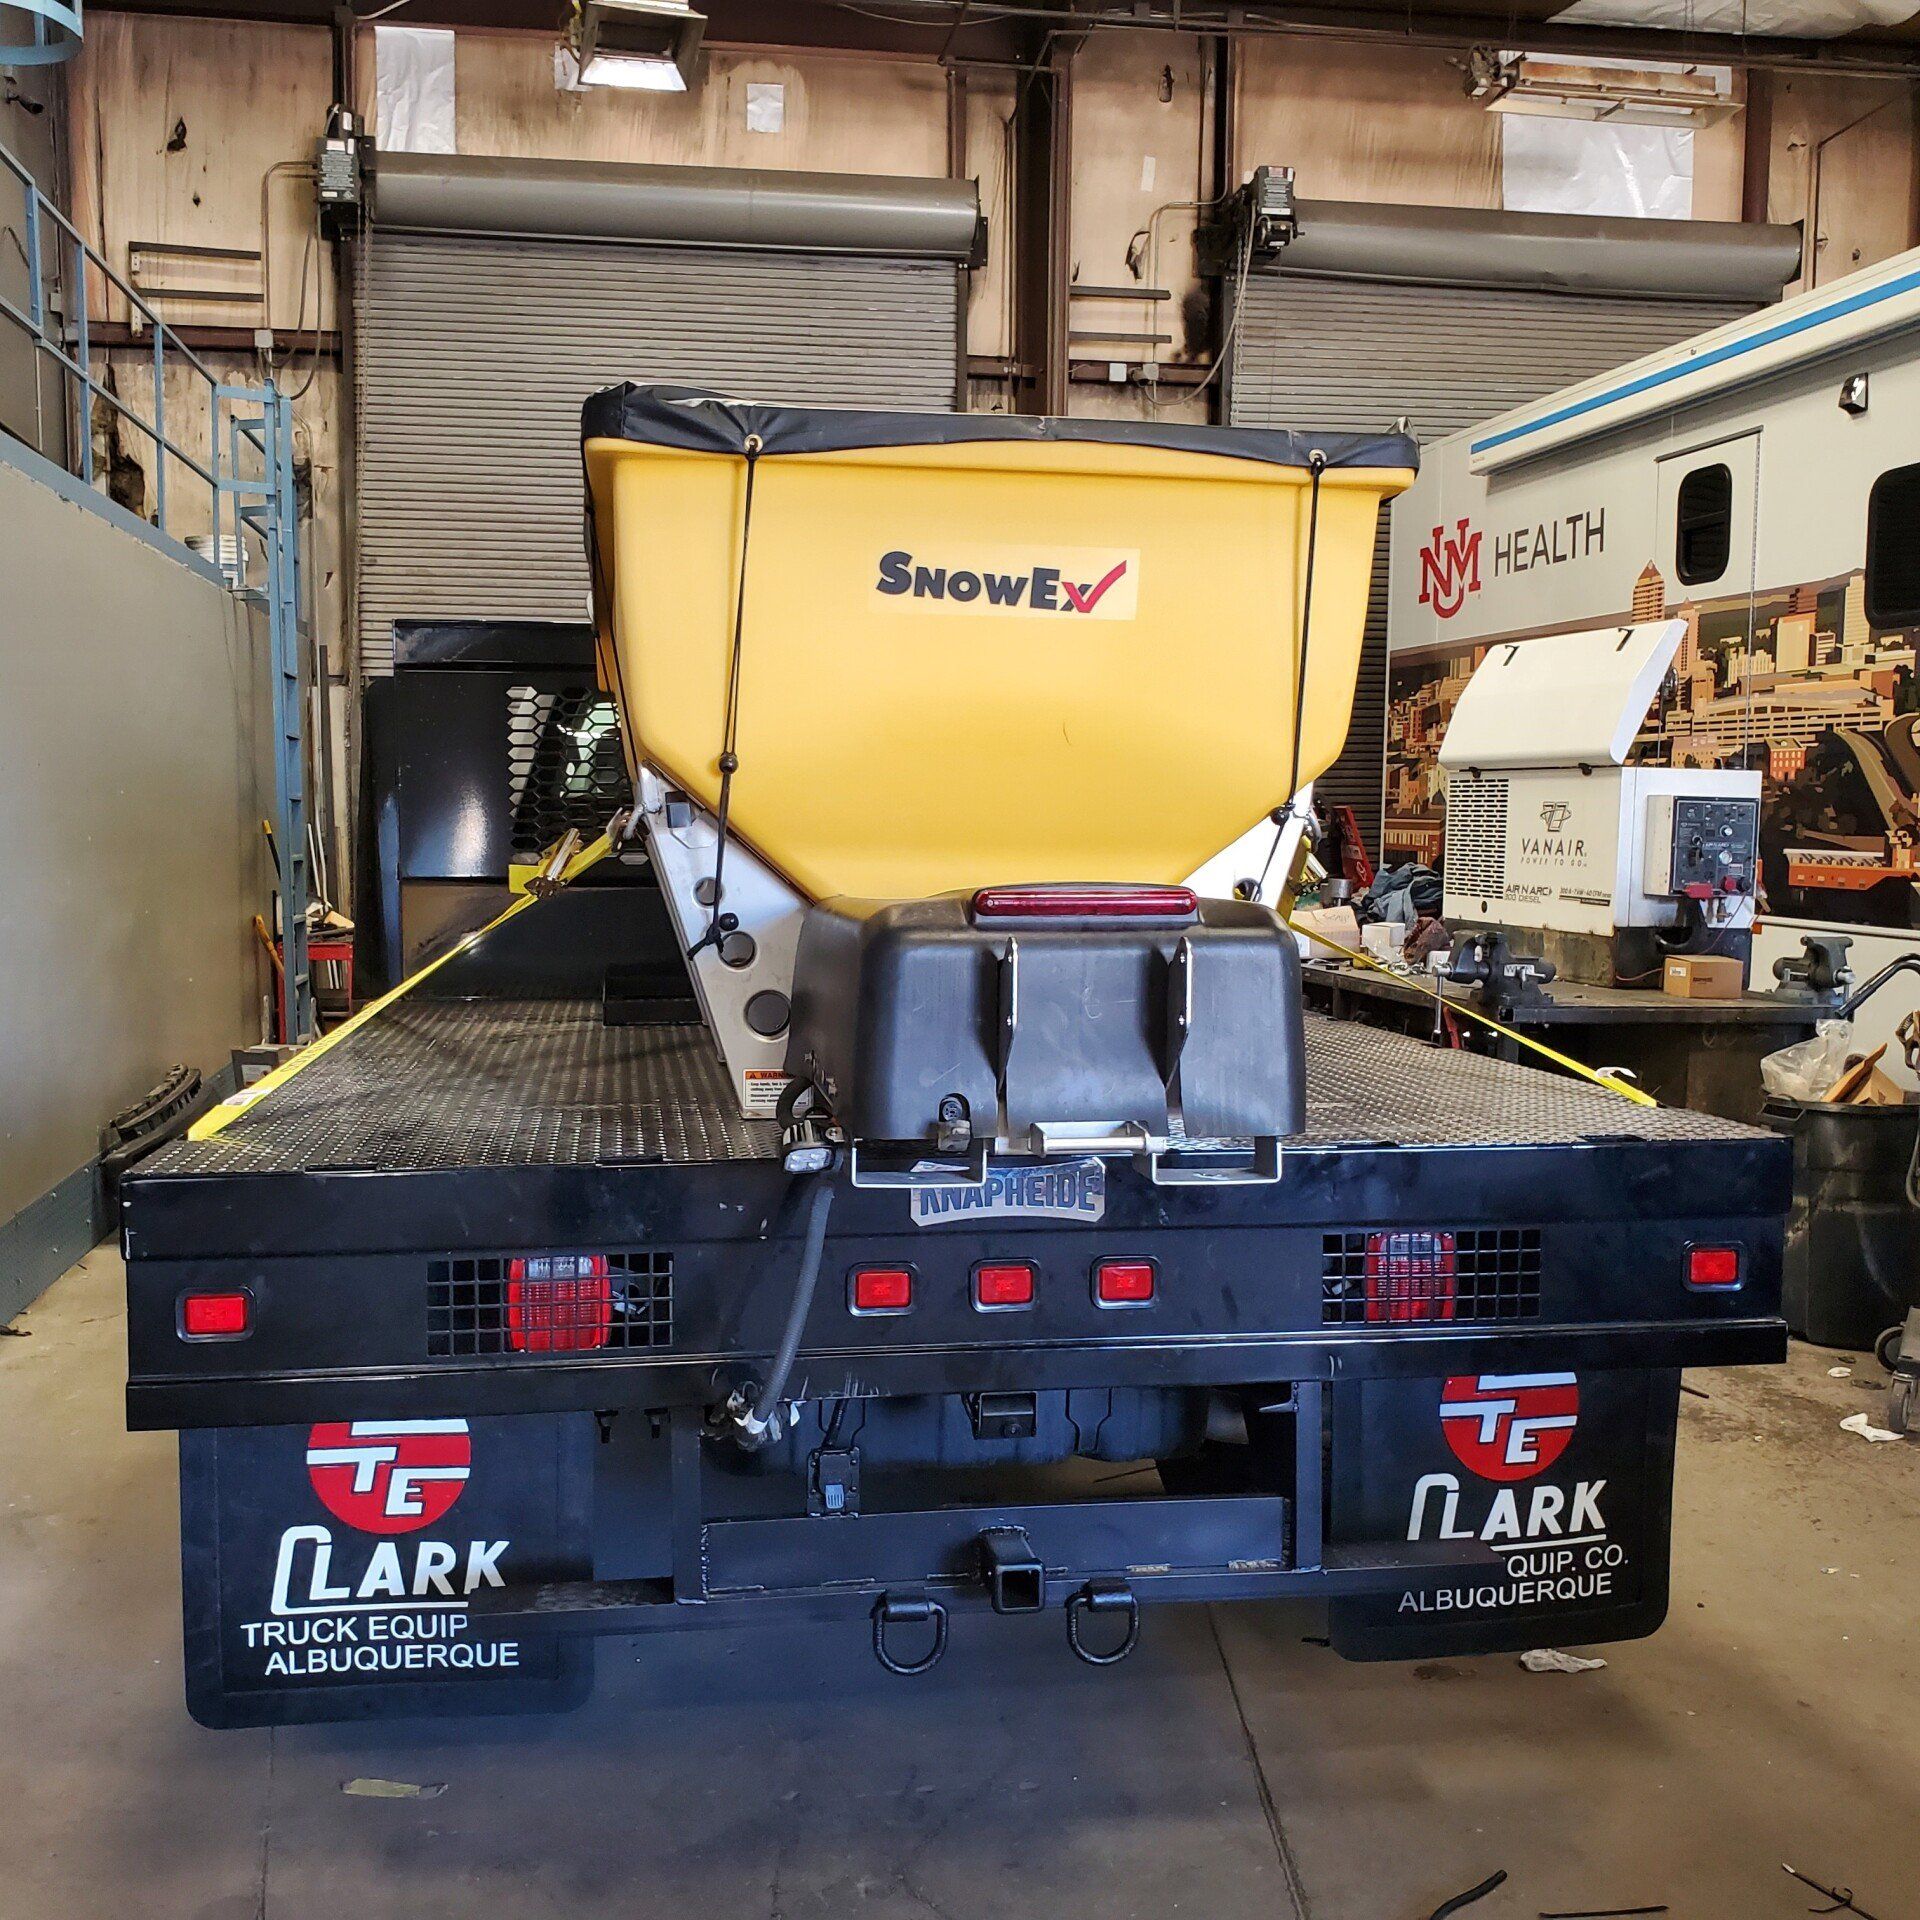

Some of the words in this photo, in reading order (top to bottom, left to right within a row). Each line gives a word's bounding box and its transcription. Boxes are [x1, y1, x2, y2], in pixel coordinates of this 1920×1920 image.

[1494, 507, 1605, 577] HEALTH
[1521, 838, 1585, 857] VANAIR
[269, 1524, 510, 1615] CLARK
[1584, 1544, 1629, 1569] CO.
[1397, 1572, 1612, 1613] ALBUQUERQUE
[241, 1616, 358, 1649] TRUCK
[368, 1614, 468, 1642] EQUIP
[264, 1642, 520, 1676] ALBUQUERQUE
